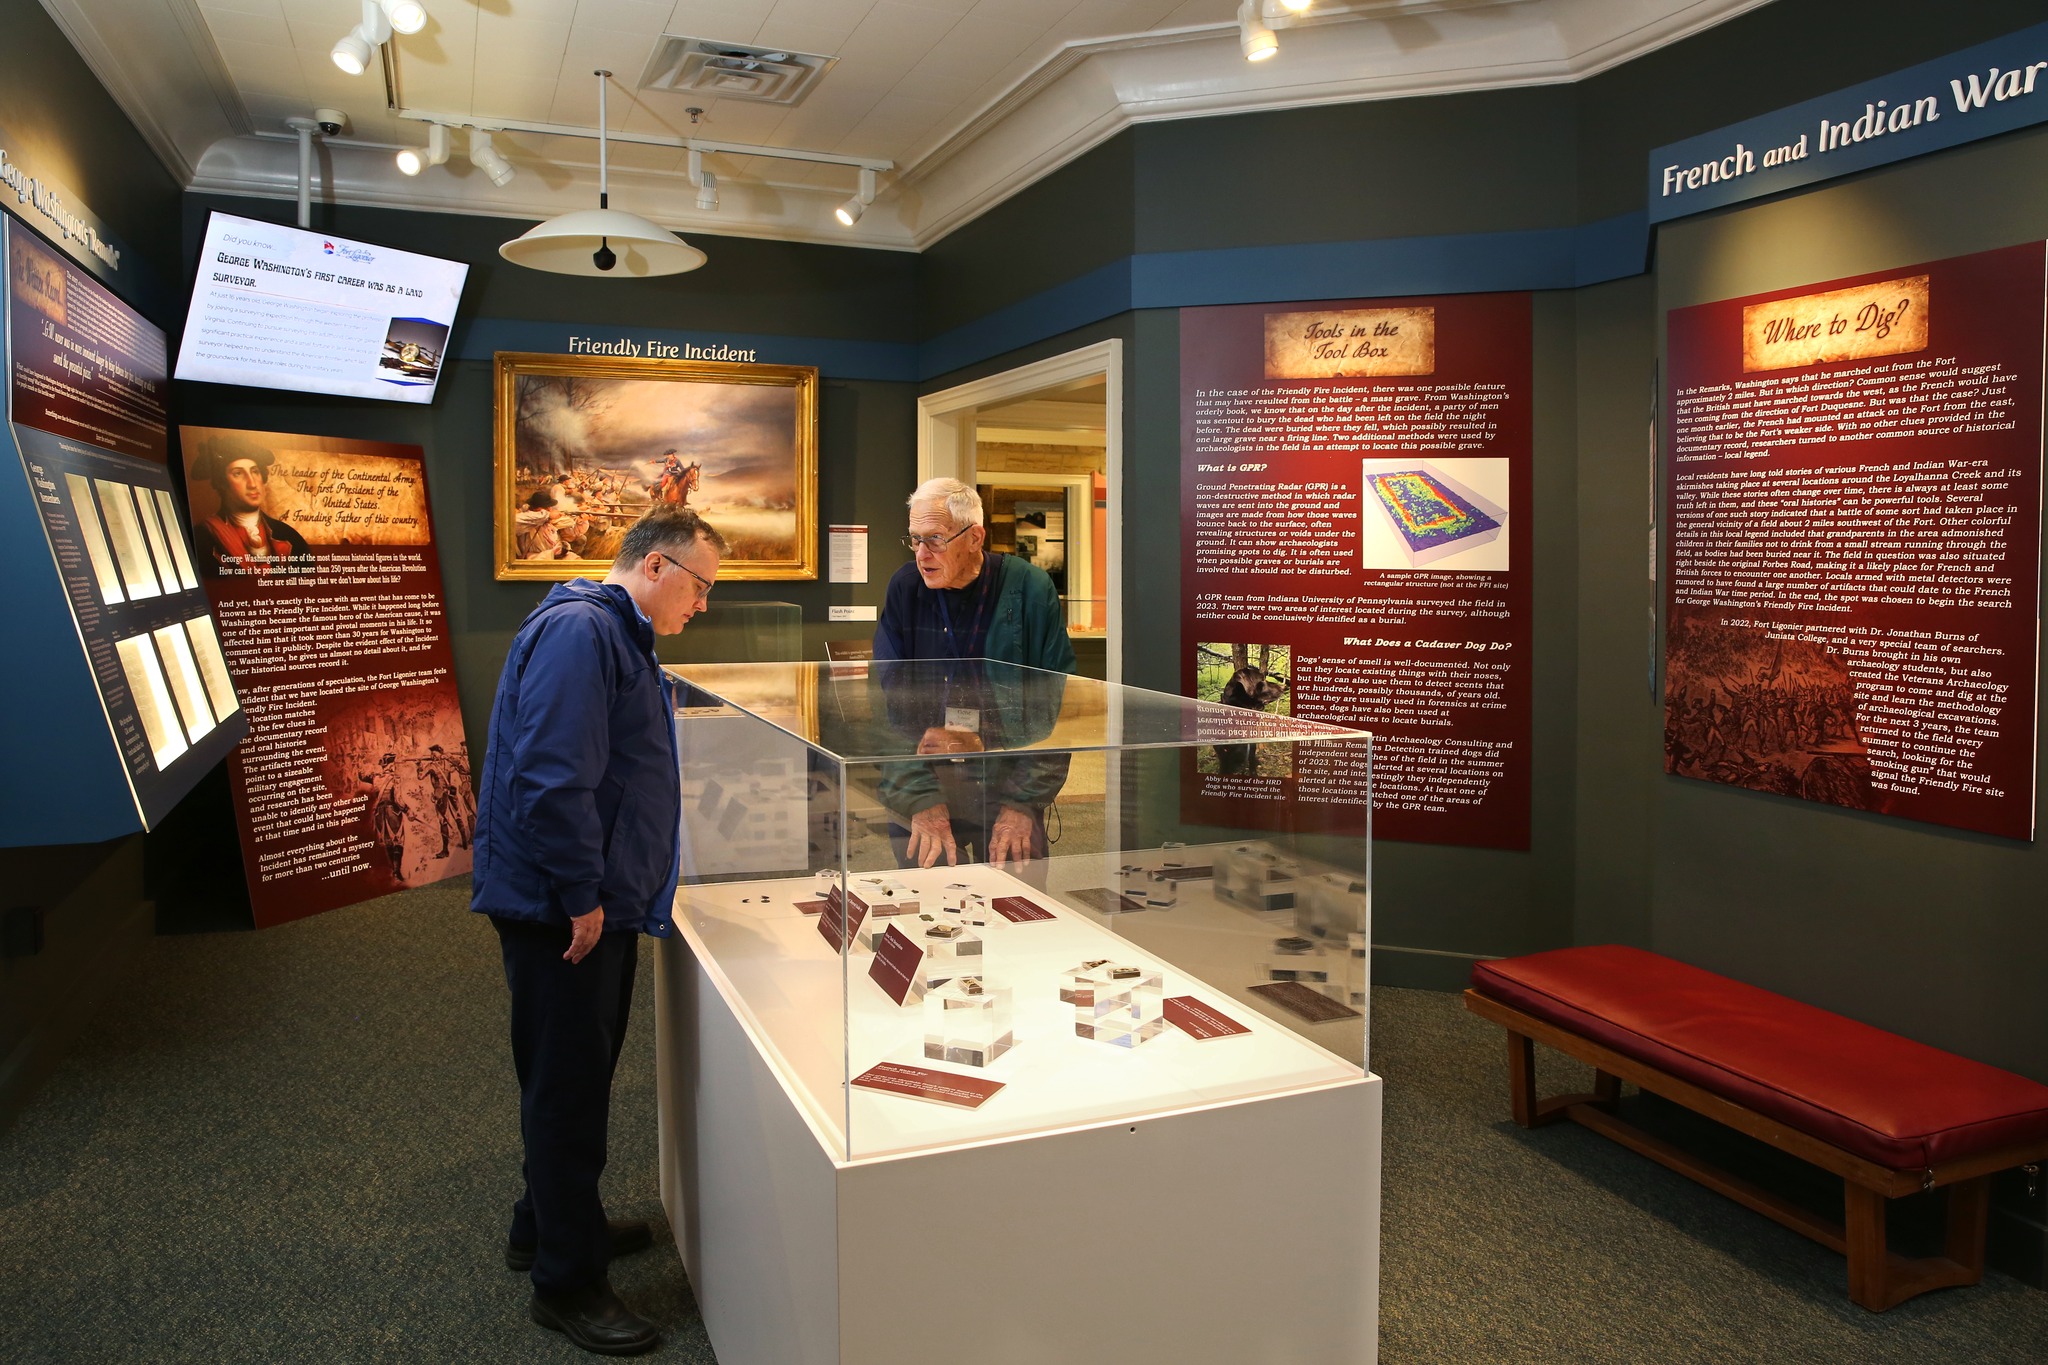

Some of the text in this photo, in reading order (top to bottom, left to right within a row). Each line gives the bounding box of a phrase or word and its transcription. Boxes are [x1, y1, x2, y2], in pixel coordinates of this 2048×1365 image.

[1662, 61, 2047, 196] French and Indian War
[223, 234, 238, 243] Did
[237, 237, 252, 247] you
[1304, 321, 1399, 339] Tools in the
[1764, 299, 1910, 345] Where to Dig?
[569, 337, 756, 362] Friendly Fire Incident
[1313, 340, 1389, 359] Tool Box
[271, 465, 416, 484] The leader of the Continental Army.
[1227, 463, 1237, 471] is
[1239, 463, 1267, 471] GPR?
[297, 481, 399, 498] The first President of the
[1228, 482, 1276, 492] Penetrating
[1304, 482, 1328, 491] (GPR)
[322, 496, 380, 509] United States.
[279, 509, 419, 528] A Founding Father of this country.
[220, 554, 243, 564] George
[244, 554, 280, 564] Washington
[280, 553, 287, 562] is
[298, 553, 305, 561] of
[306, 553, 316, 561] the
[331, 553, 350, 561] famous
[351, 553, 375, 561] historical
[375, 553, 392, 563] figures
[1343, 637, 1372, 646] What
[1374, 638, 1401, 647] Does
[1414, 639, 1462, 648] Cadaver
[1464, 641, 1486, 652] Dog
[1489, 642, 1512, 650] Do?
[1204, 775, 1221, 783] Abby
[1870, 770, 2004, 797] signal the Friendly Fire site
[1936, 768, 1957, 778] that
[1959, 773, 1991, 783] would
[1200, 789, 1227, 798] Friendly
[1870, 781, 1920, 795] was found.
[258, 834, 358, 862] Almost everything about the
[260, 859, 291, 872] Incident
[292, 856, 306, 864] has
[308, 846, 341, 861] remained
[348, 840, 375, 852] mystery
[261, 853, 360, 882] for more than two centuries
[352, 862, 372, 872] now.
